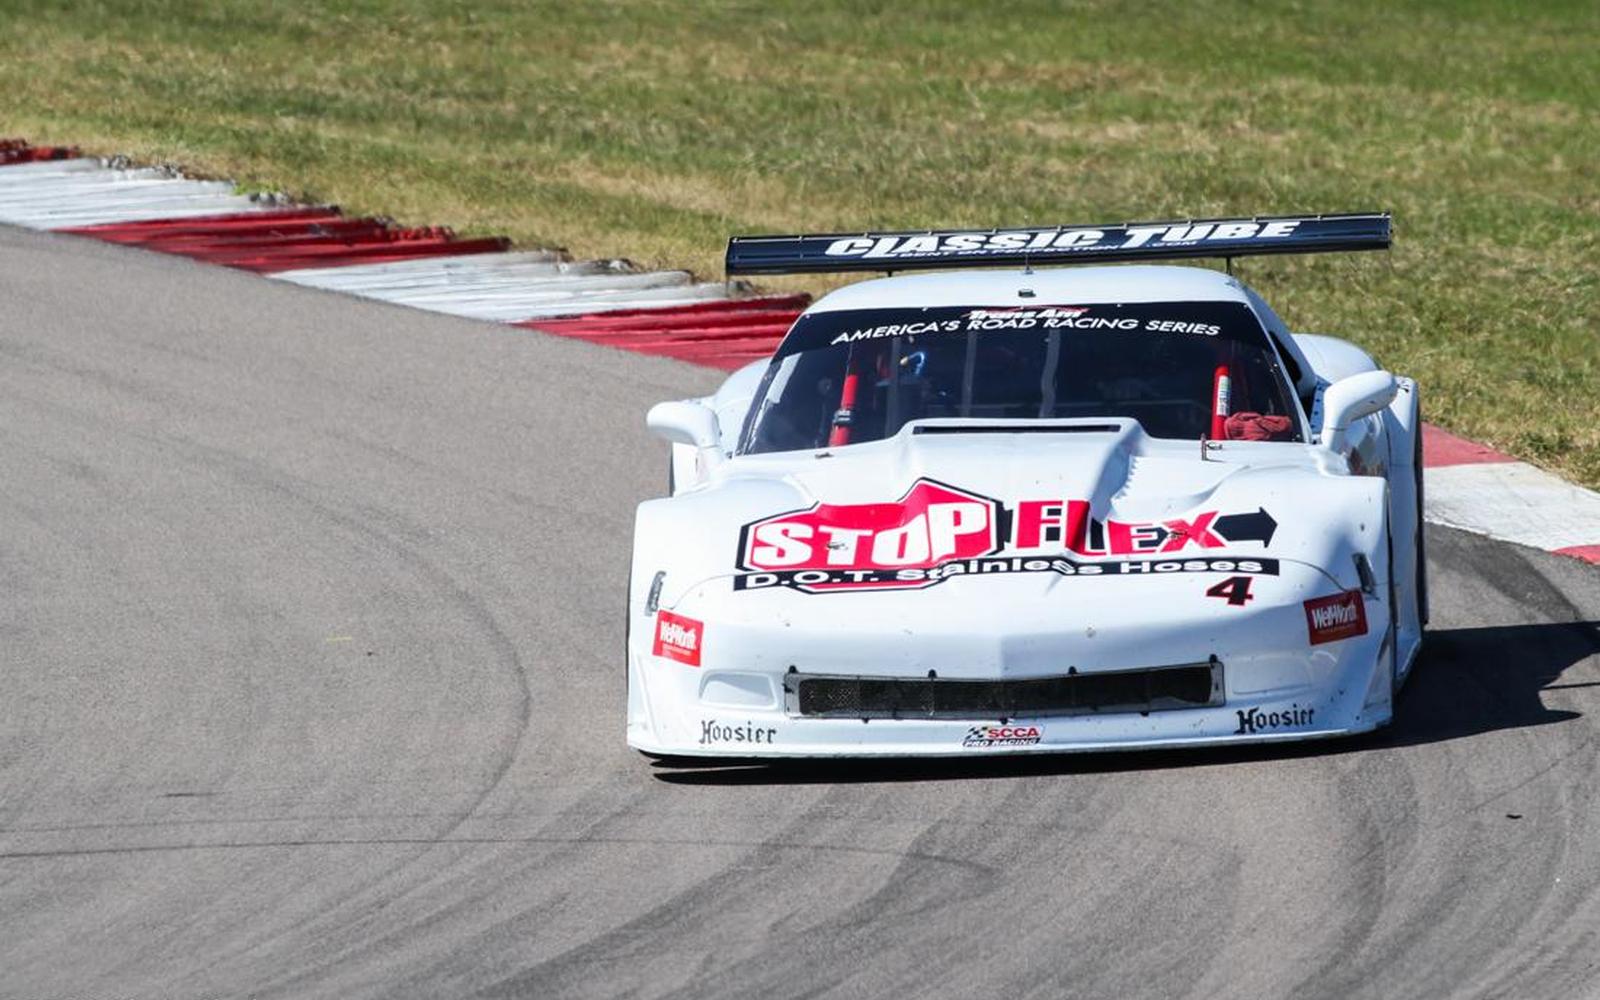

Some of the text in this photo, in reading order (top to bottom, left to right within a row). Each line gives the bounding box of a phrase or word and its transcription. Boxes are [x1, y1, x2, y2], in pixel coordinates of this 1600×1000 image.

[825, 221, 1300, 258] CLASSIC TUBE
[831, 318, 1221, 345] AMERICA'S ROAD RACING SERIES
[752, 500, 1226, 567] STOP FLEX
[746, 558, 1262, 588] D.O.T. Stainless Hoses
[1206, 576, 1254, 606] 4
[699, 720, 776, 744] Hoosier
[987, 727, 1039, 737] SCCA
[1233, 703, 1315, 734] Hoosier
